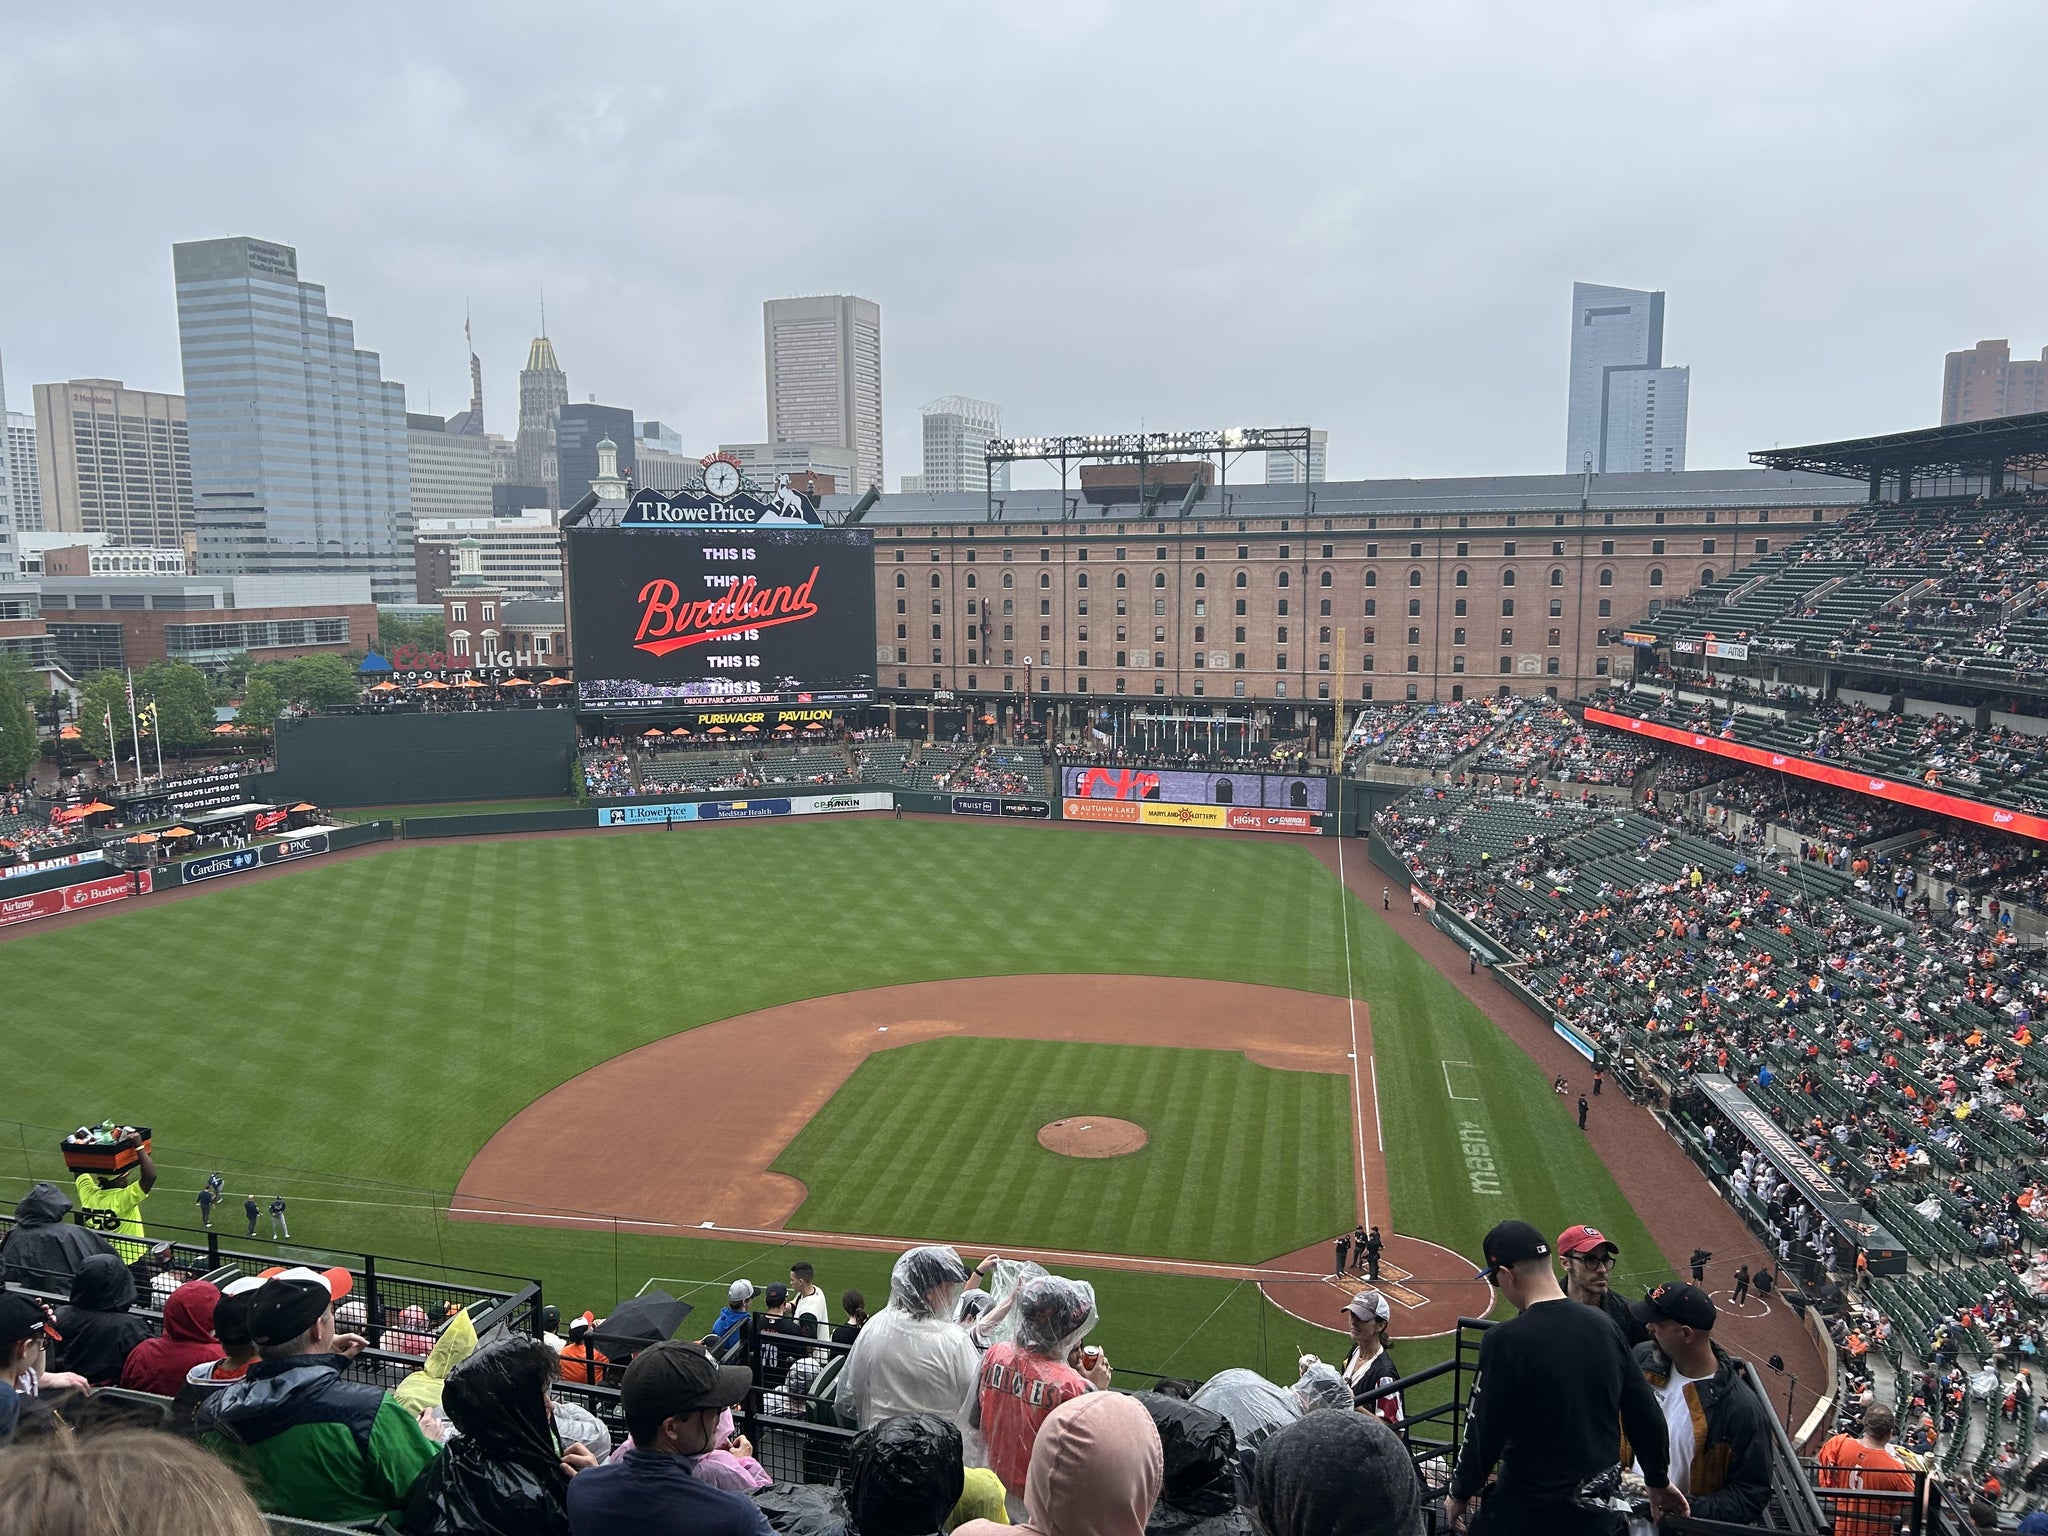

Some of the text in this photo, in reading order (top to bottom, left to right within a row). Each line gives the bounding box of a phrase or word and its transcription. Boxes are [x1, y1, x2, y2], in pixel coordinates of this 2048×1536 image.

[703, 548, 756, 560] THIS IS
[704, 575, 739, 587] THIS
[634, 565, 820, 640] Birdland
[744, 629, 759, 640] IS
[391, 642, 548, 670] Coors LIGHT
[707, 655, 760, 668] THIS IS
[393, 668, 516, 680] ROOF DECK
[708, 682, 761, 694] THIS IS
[698, 710, 833, 724] PUREWAGER PAVILION
[166, 780, 182, 788] LET'S
[204, 786, 220, 794] LET'S
[718, 808, 772, 818] MedStar Health
[1080, 804, 1136, 814] AUTUMN LAKE
[1148, 810, 1178, 818] MARYLAND
[1233, 816, 1261, 827] HIGH'S
[290, 839, 310, 852] PNC
[5, 856, 70, 878] BIRD BATH
[190, 857, 233, 877] CareFirst
[2, 900, 34, 912] Airtemp
[1459, 1128, 1502, 1195] masn
